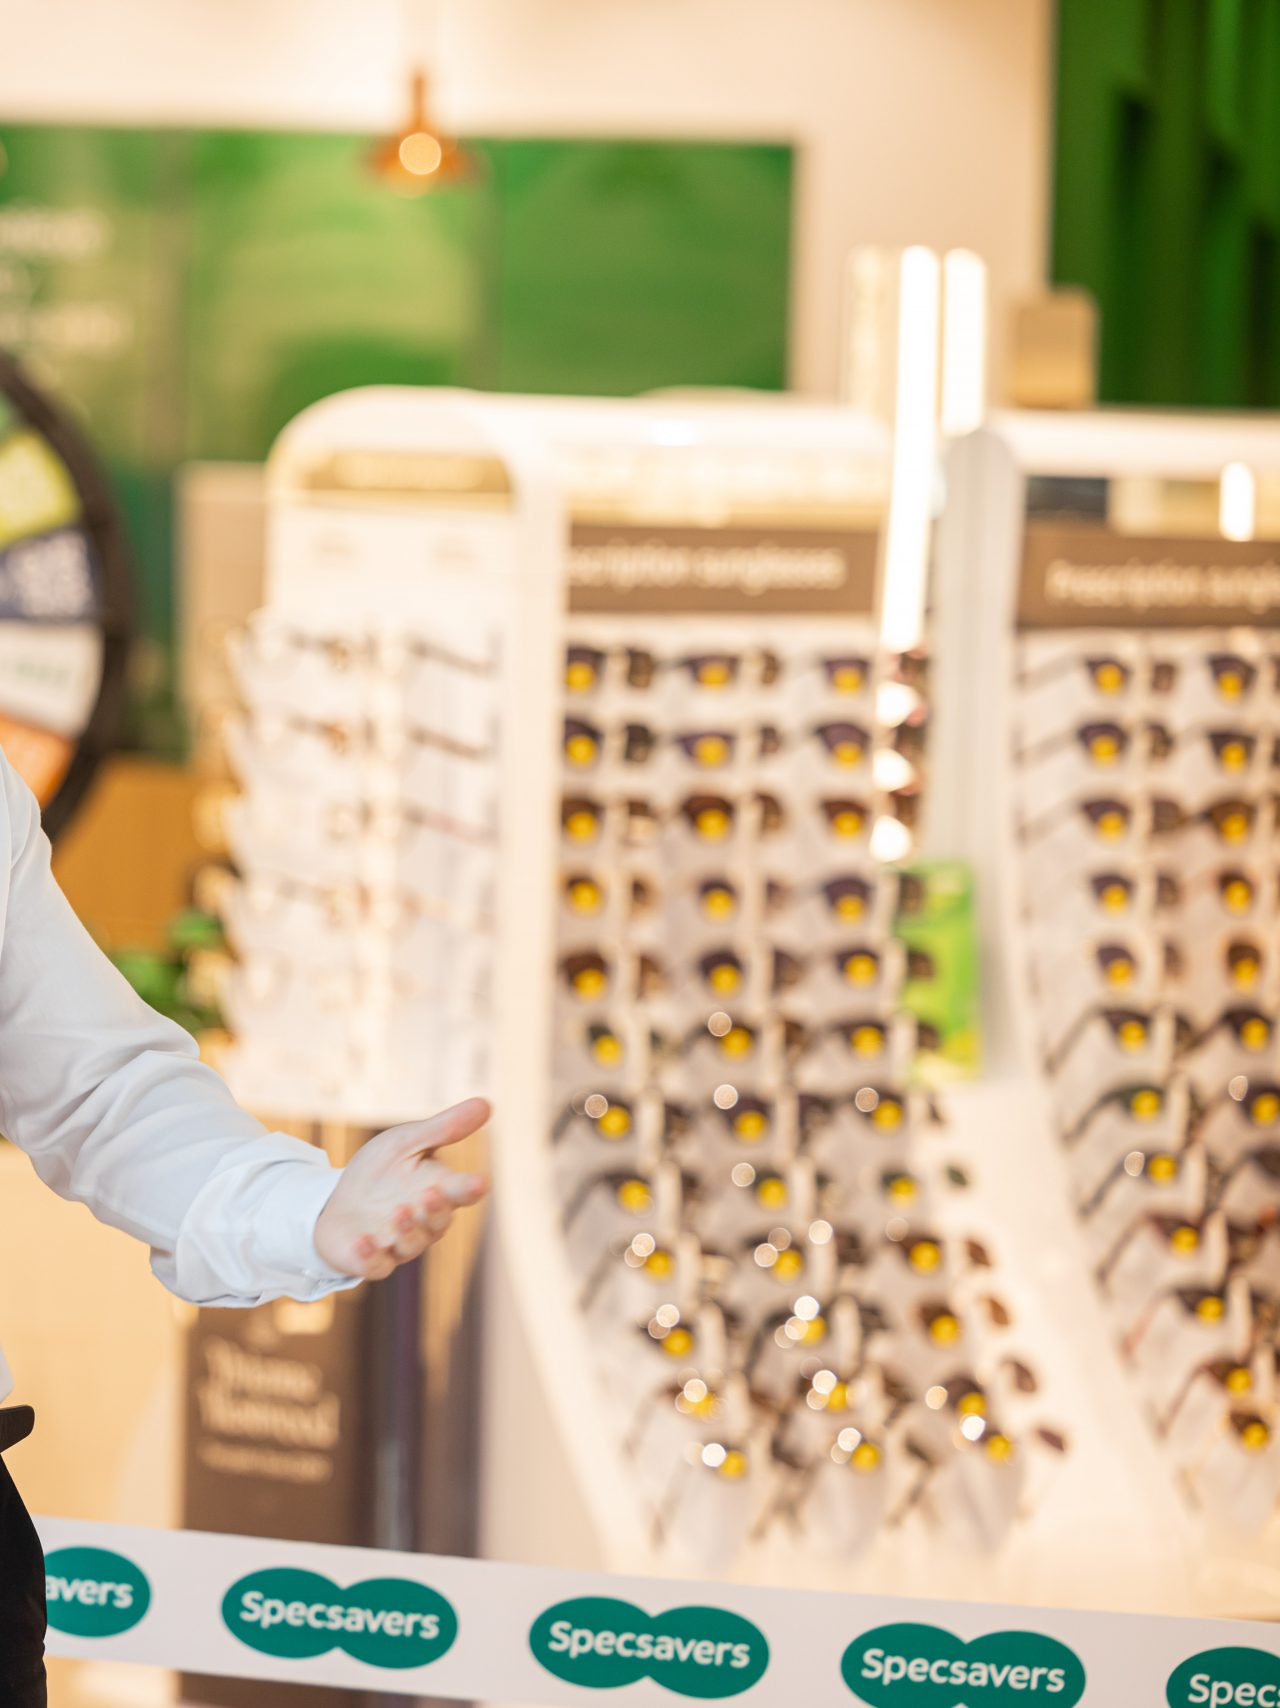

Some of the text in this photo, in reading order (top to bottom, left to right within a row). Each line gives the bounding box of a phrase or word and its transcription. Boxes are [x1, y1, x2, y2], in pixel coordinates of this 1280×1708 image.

[239, 1590, 440, 1640] Specsavers
[548, 1620, 750, 1668] Specsavers
[861, 1648, 1065, 1692] Specsavers
[1187, 1673, 1280, 1708] Spec
